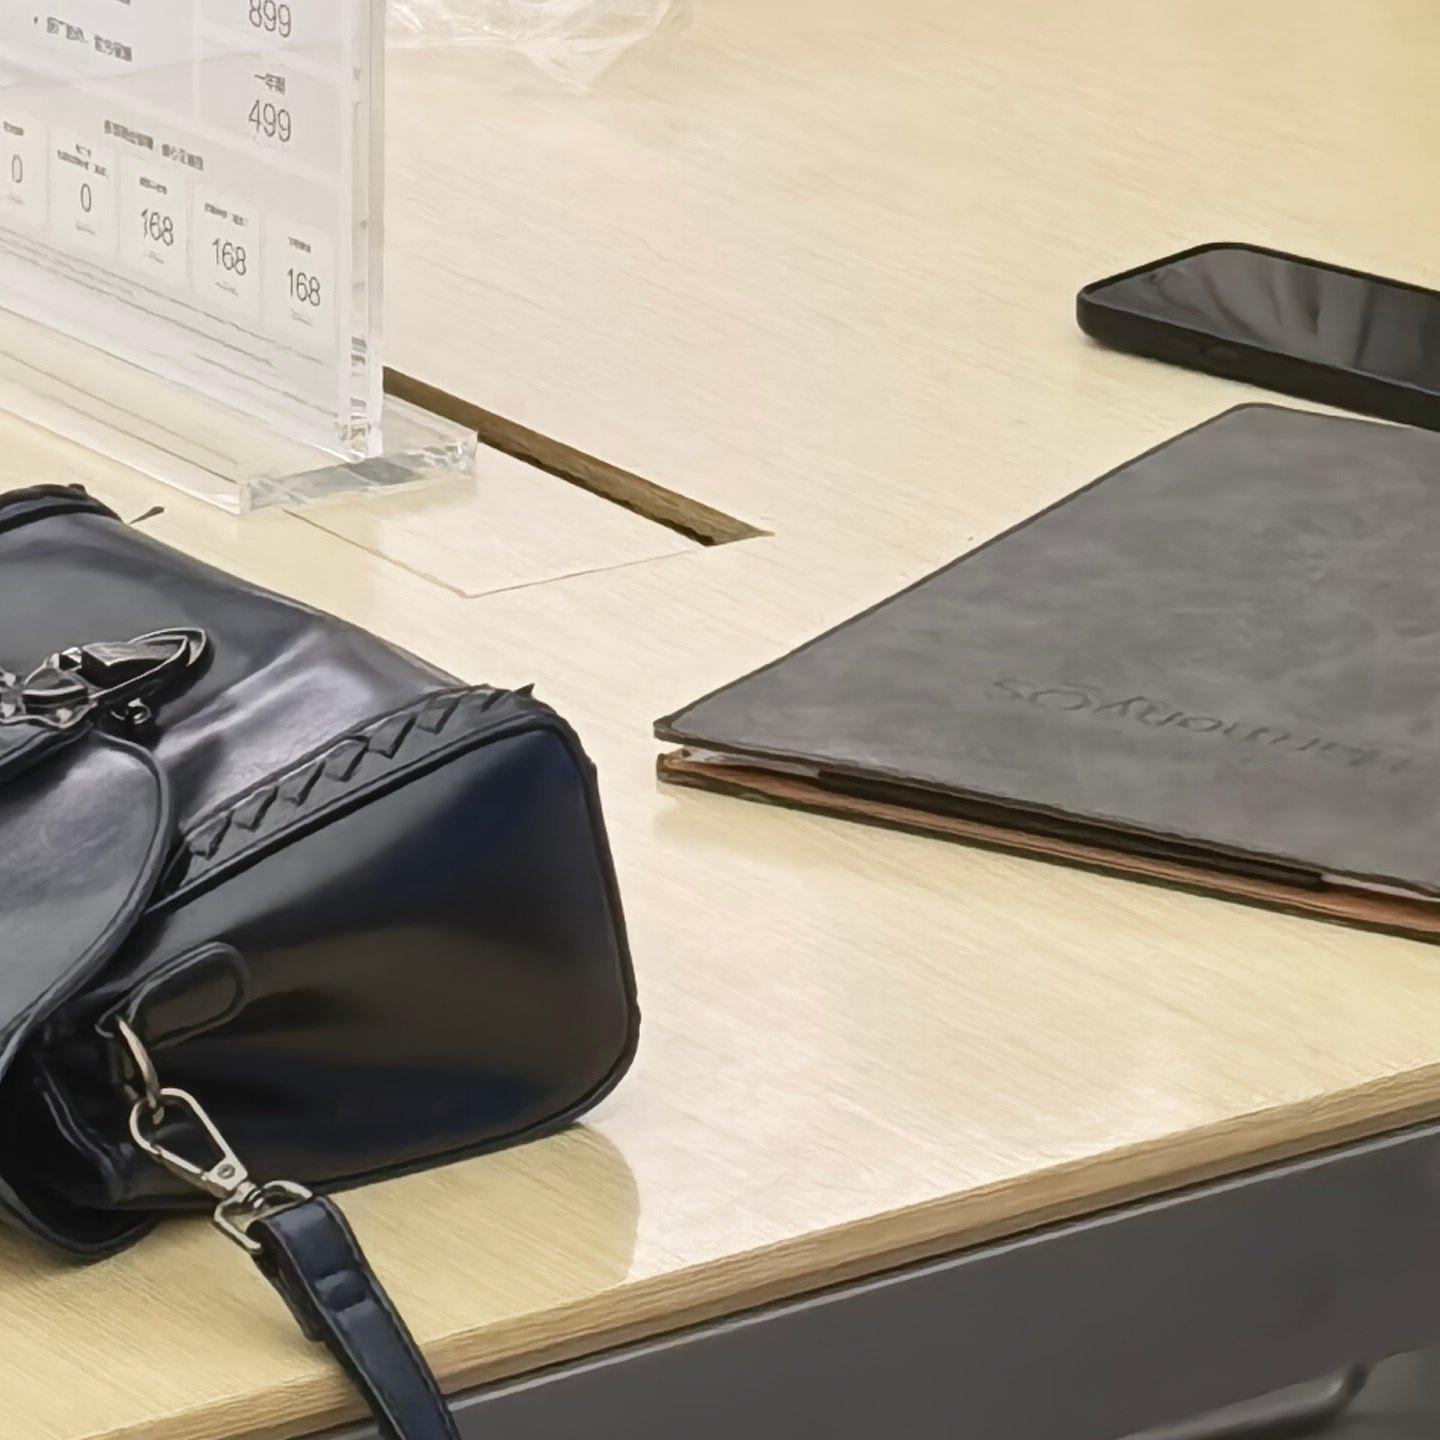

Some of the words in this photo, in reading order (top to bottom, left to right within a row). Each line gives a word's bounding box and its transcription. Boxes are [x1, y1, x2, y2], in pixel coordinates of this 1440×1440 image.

[248, 99, 291, 143] 499
[140, 208, 174, 246] 168
[212, 238, 247, 276] 168
[286, 268, 321, 307] 168
